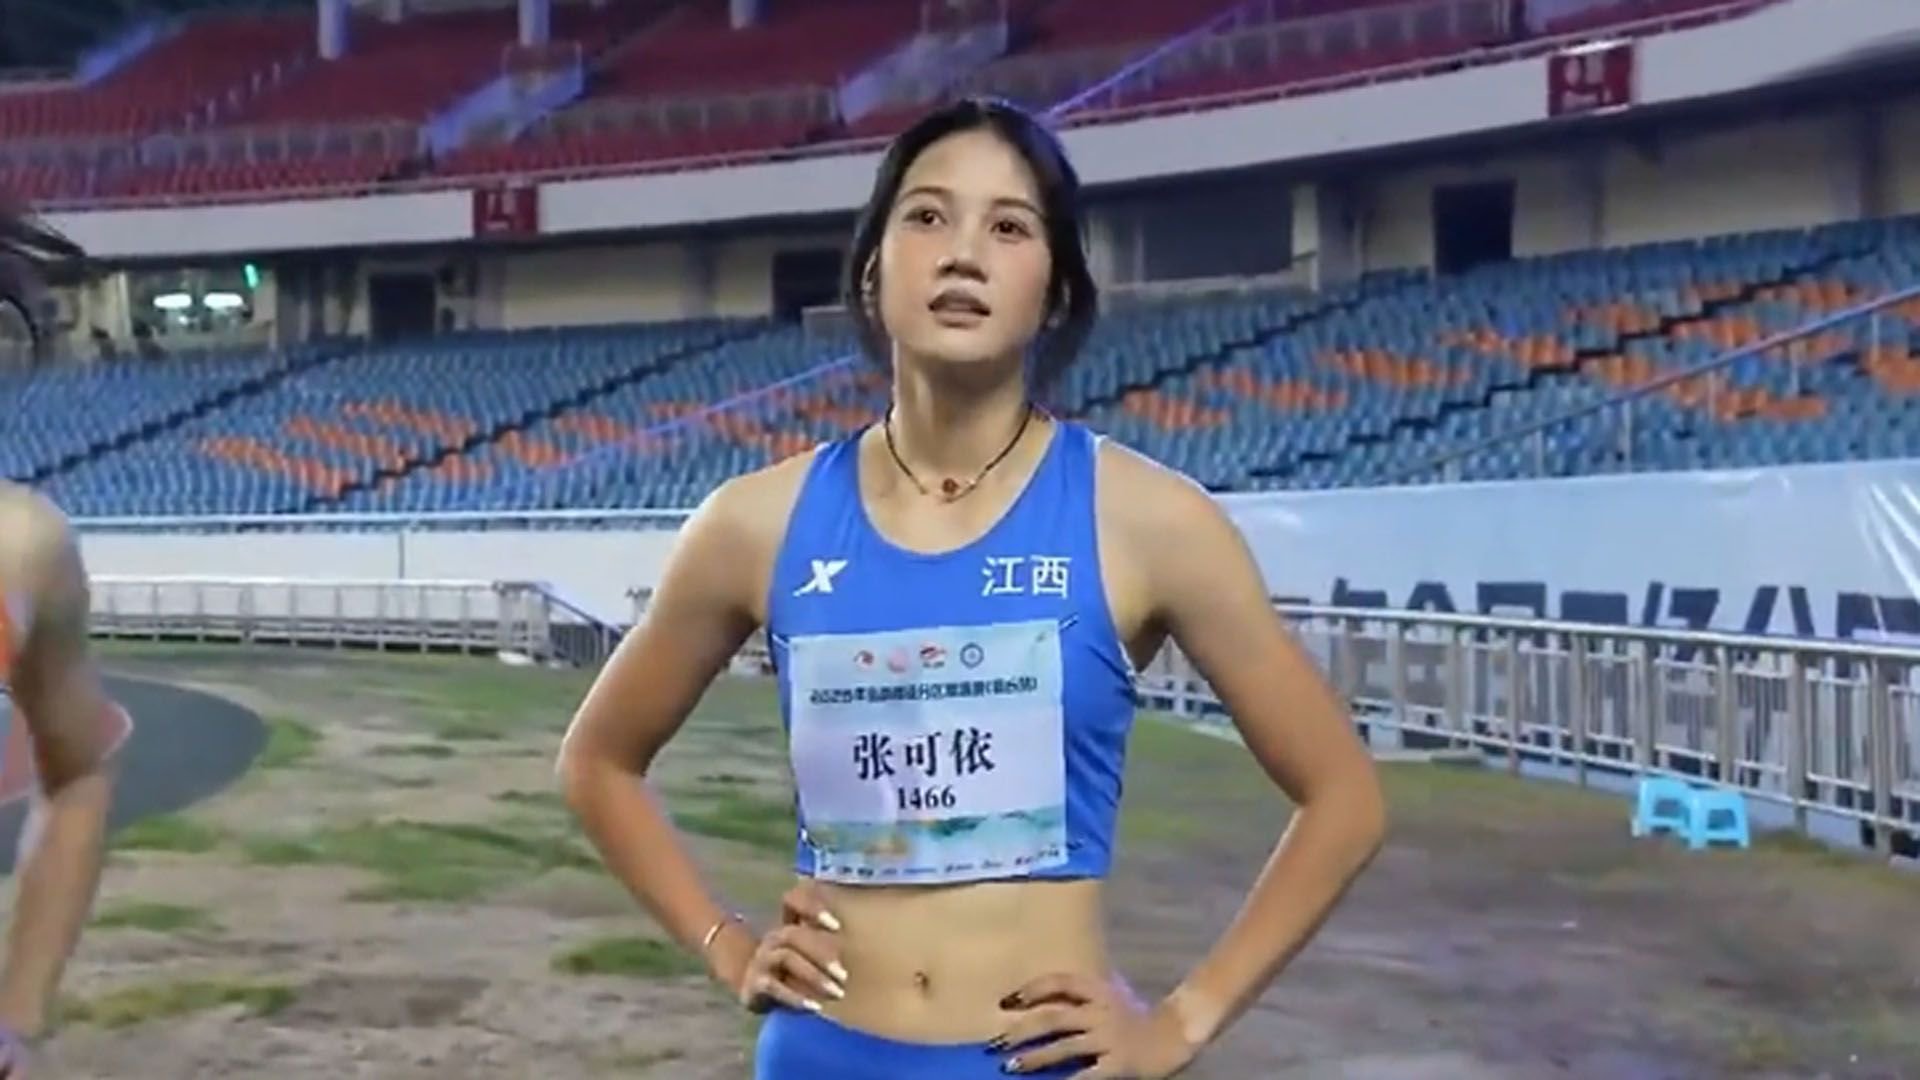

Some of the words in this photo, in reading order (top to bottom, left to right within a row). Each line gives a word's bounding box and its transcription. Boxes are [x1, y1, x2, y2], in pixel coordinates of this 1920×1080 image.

[981, 555, 1072, 599] 江西
[853, 727, 995, 780] 张可依
[898, 785, 957, 810] 1466
